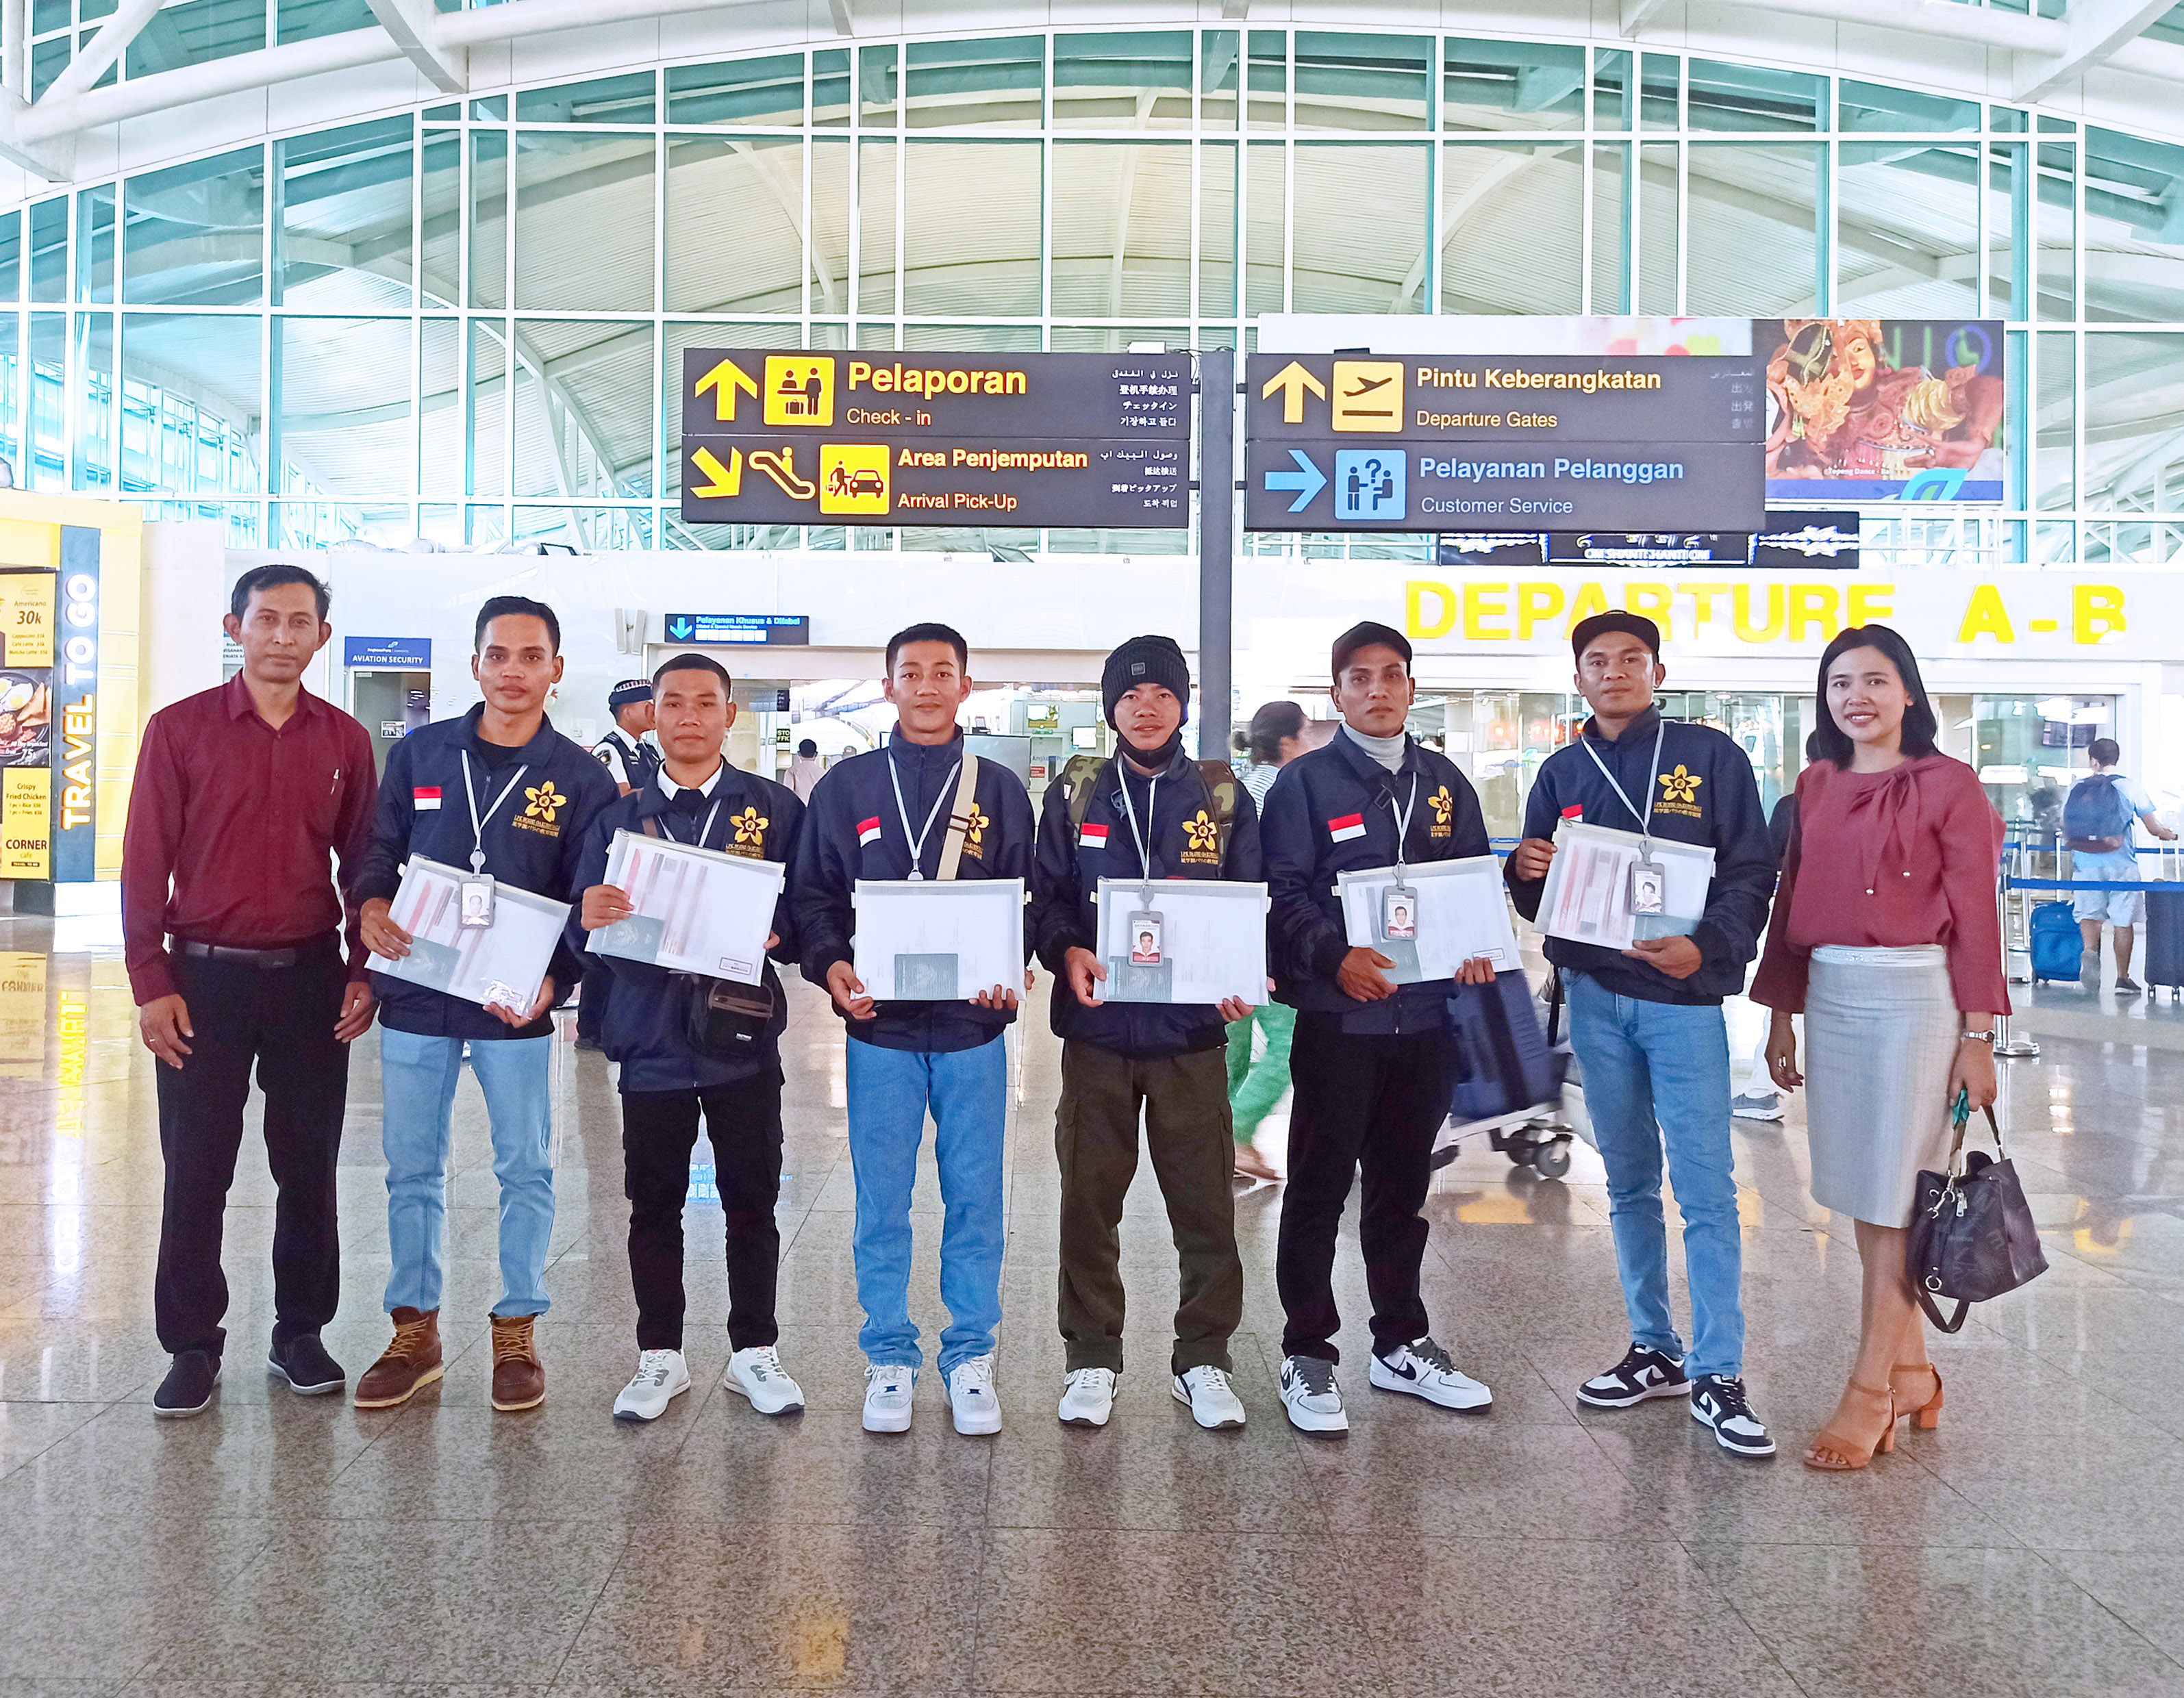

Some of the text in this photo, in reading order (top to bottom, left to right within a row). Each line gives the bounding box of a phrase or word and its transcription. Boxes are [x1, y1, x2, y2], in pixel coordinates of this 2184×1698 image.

[848, 362, 1027, 401] Pelaporan
[1417, 368, 1661, 393] Pintu Keberangkatan
[1122, 401, 1177, 411] チェックイン
[846, 408, 900, 425] Check
[916, 409, 931, 425] in
[1416, 410, 1558, 429] Departure Gates
[897, 448, 1088, 472] Area Penjemputan
[1420, 457, 1684, 484] Pelayanan Pelanggan
[898, 493, 1018, 513] Arrival Pick-Up
[1421, 496, 1573, 515] Customer Service
[17, 610, 42, 624] 30k
[696, 616, 735, 626] Pelayanan
[736, 617, 764, 625] Khusus
[1405, 581, 1895, 644] DEPARTURE
[353, 655, 423, 665] AVIATION SECURITY
[61, 574, 96, 830] TRAVEL TO GO
[5, 839, 47, 850] CORNER
